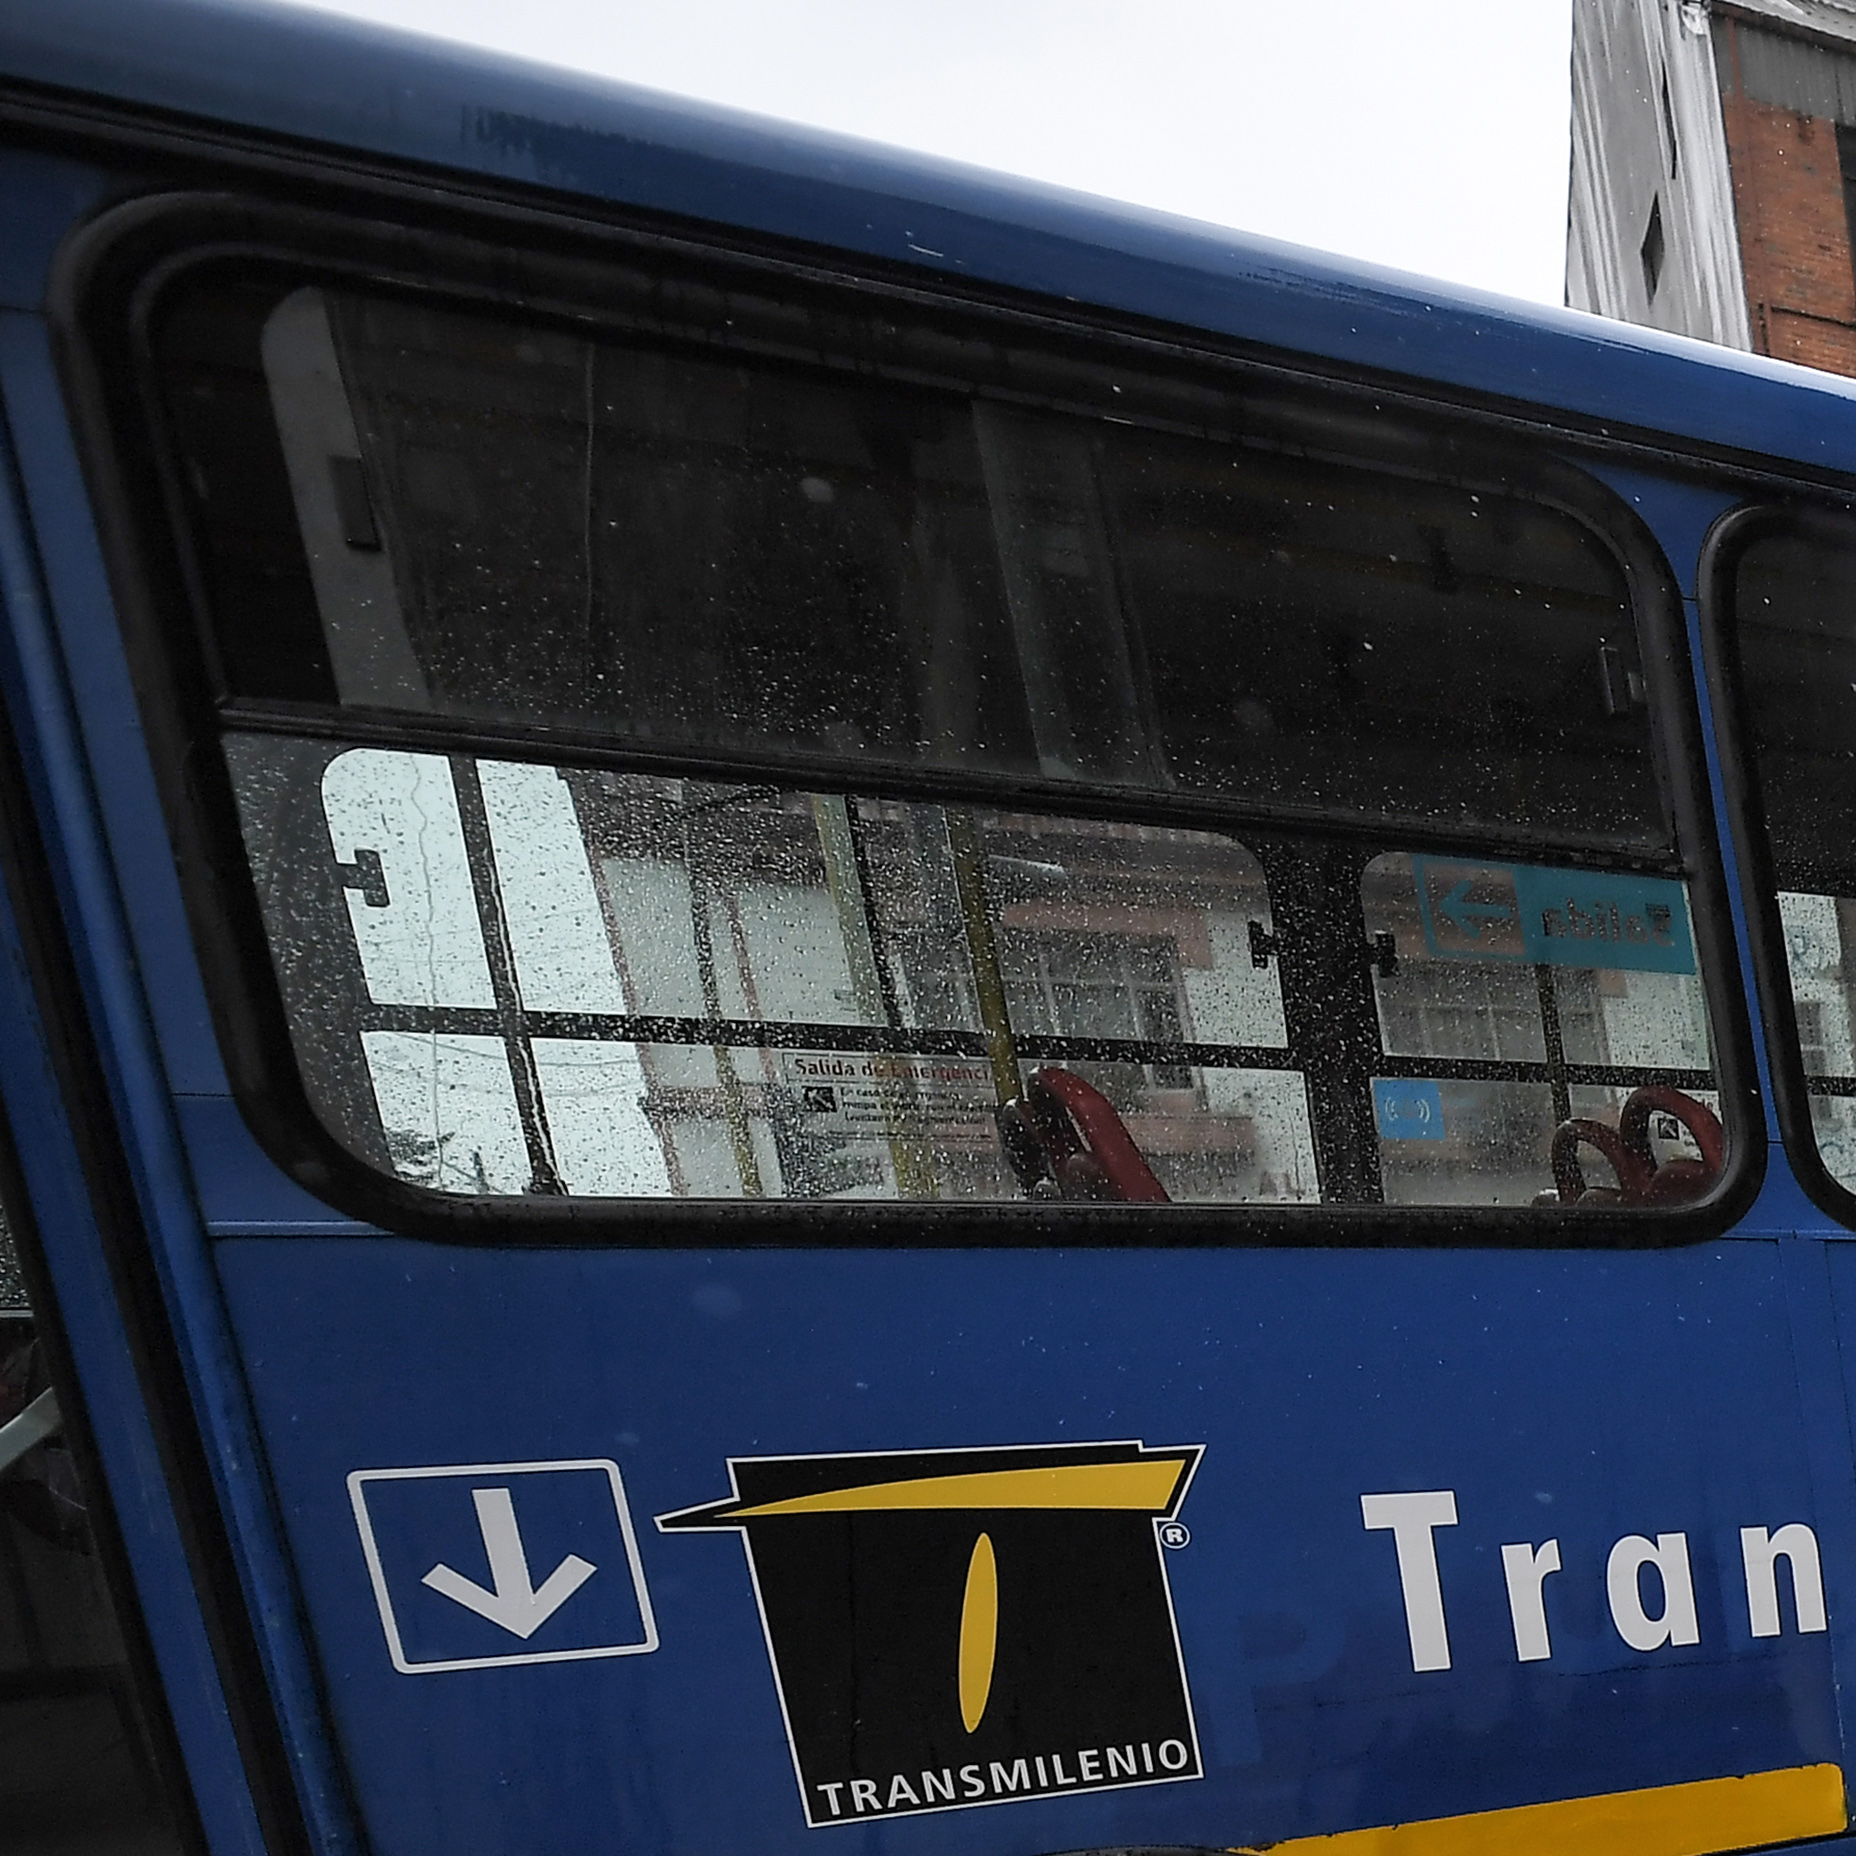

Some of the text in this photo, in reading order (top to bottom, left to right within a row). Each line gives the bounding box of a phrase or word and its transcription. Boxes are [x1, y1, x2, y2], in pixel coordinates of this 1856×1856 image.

[794, 1057, 991, 1081] Salida de Emergenci
[816, 1737, 1190, 1819] TRANSMILENIO
